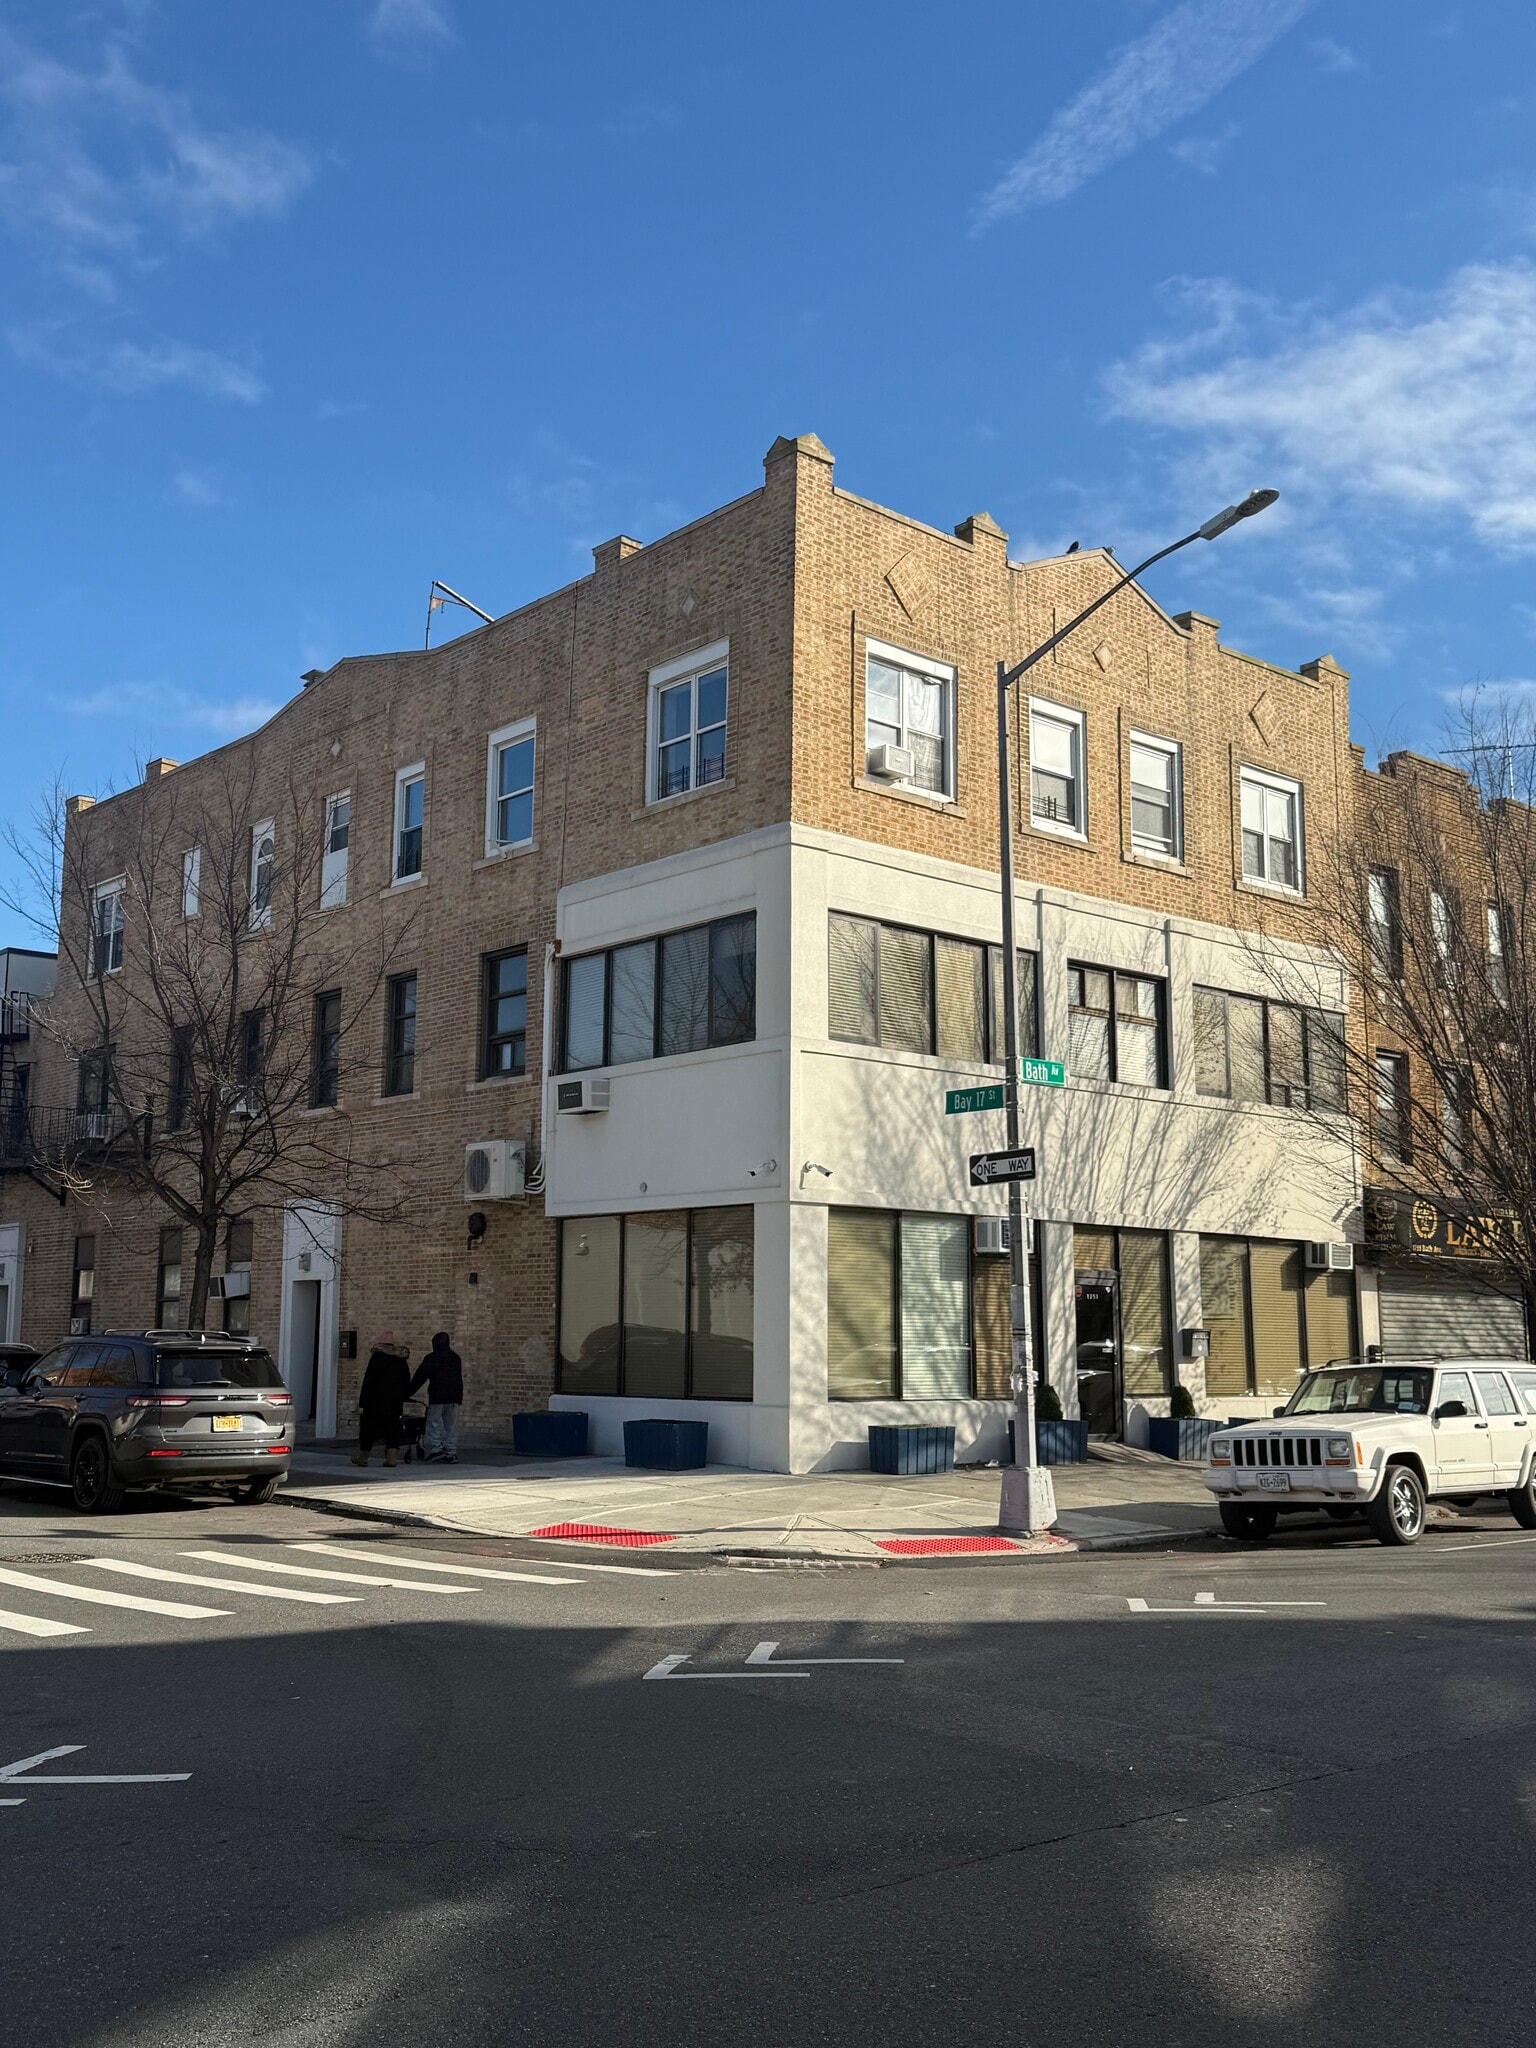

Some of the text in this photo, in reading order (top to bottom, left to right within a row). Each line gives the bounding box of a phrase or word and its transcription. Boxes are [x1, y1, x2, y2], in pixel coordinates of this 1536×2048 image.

[1025, 1061, 1059, 1081] Bath Av
[954, 1089, 996, 1112] Bay 17 St
[976, 1158, 1030, 1176] ONE WAY
[1446, 1213, 1503, 1248] LAW
